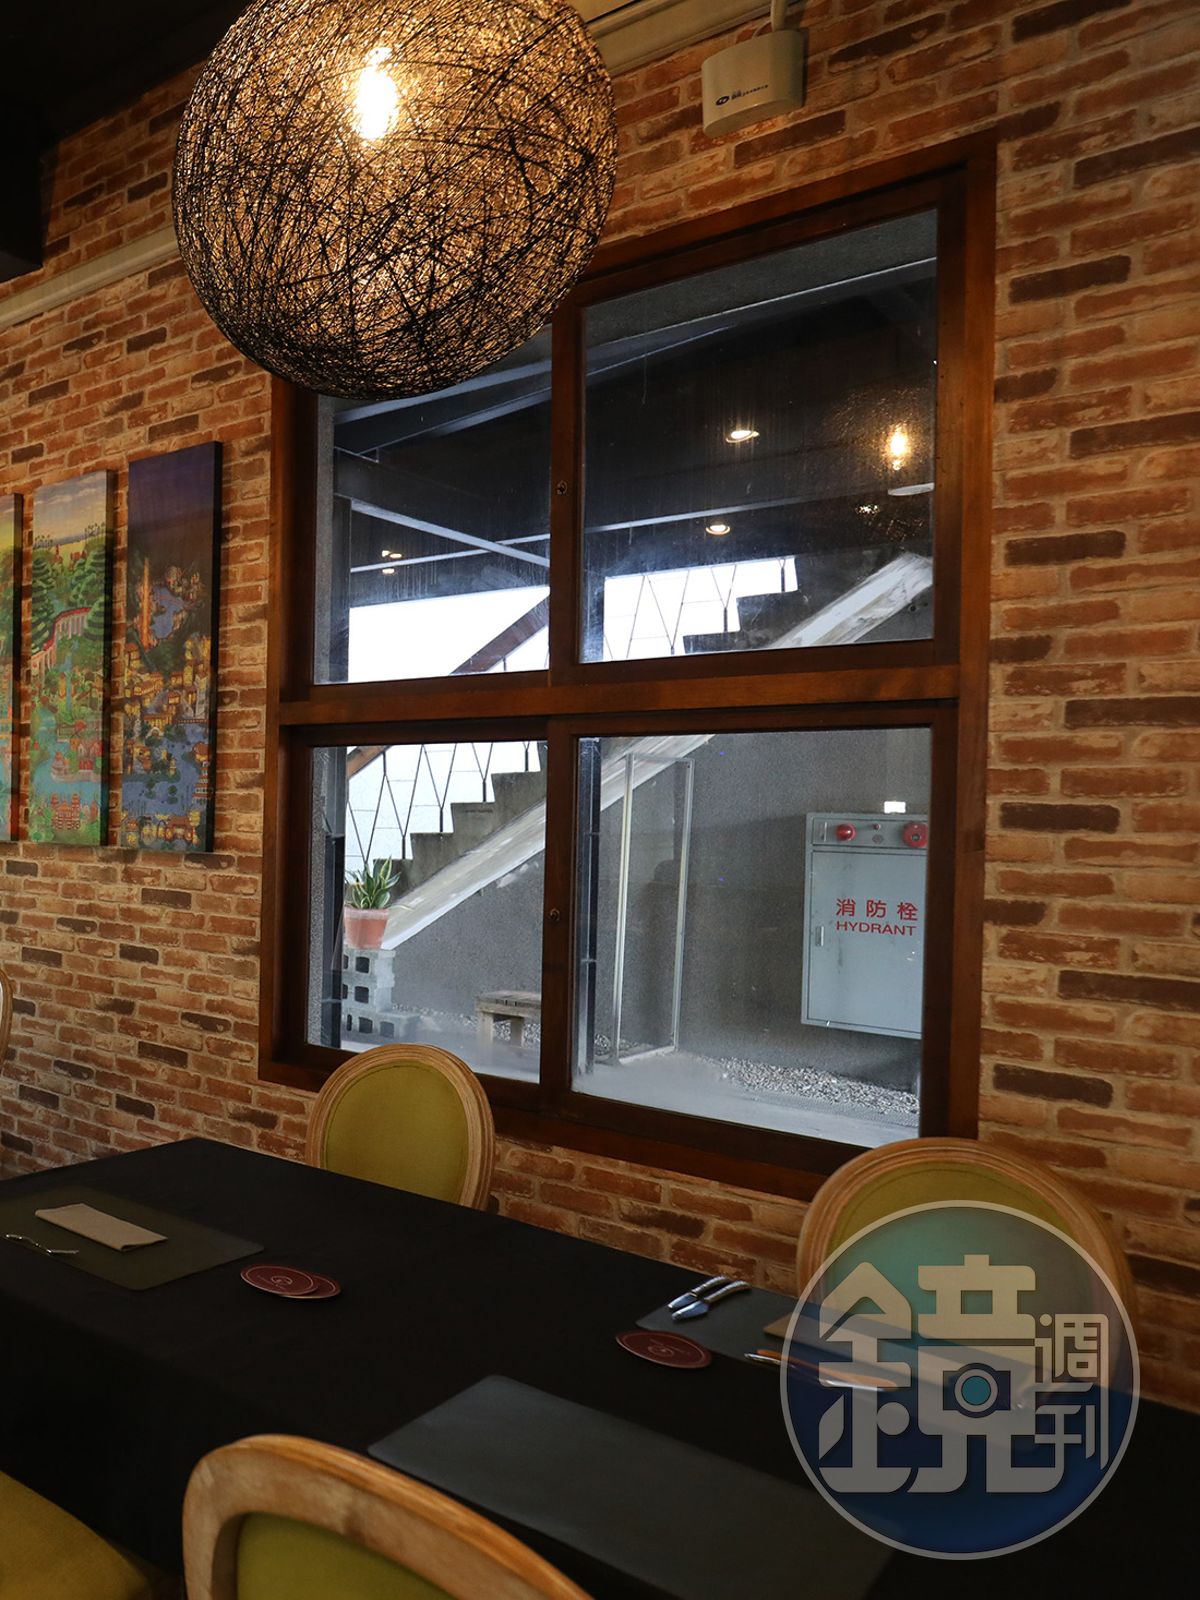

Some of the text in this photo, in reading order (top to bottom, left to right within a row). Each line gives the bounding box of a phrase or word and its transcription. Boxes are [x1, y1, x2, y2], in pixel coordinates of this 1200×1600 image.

[835, 898, 919, 922] 消防栓
[835, 921, 918, 937] HYDRANT
